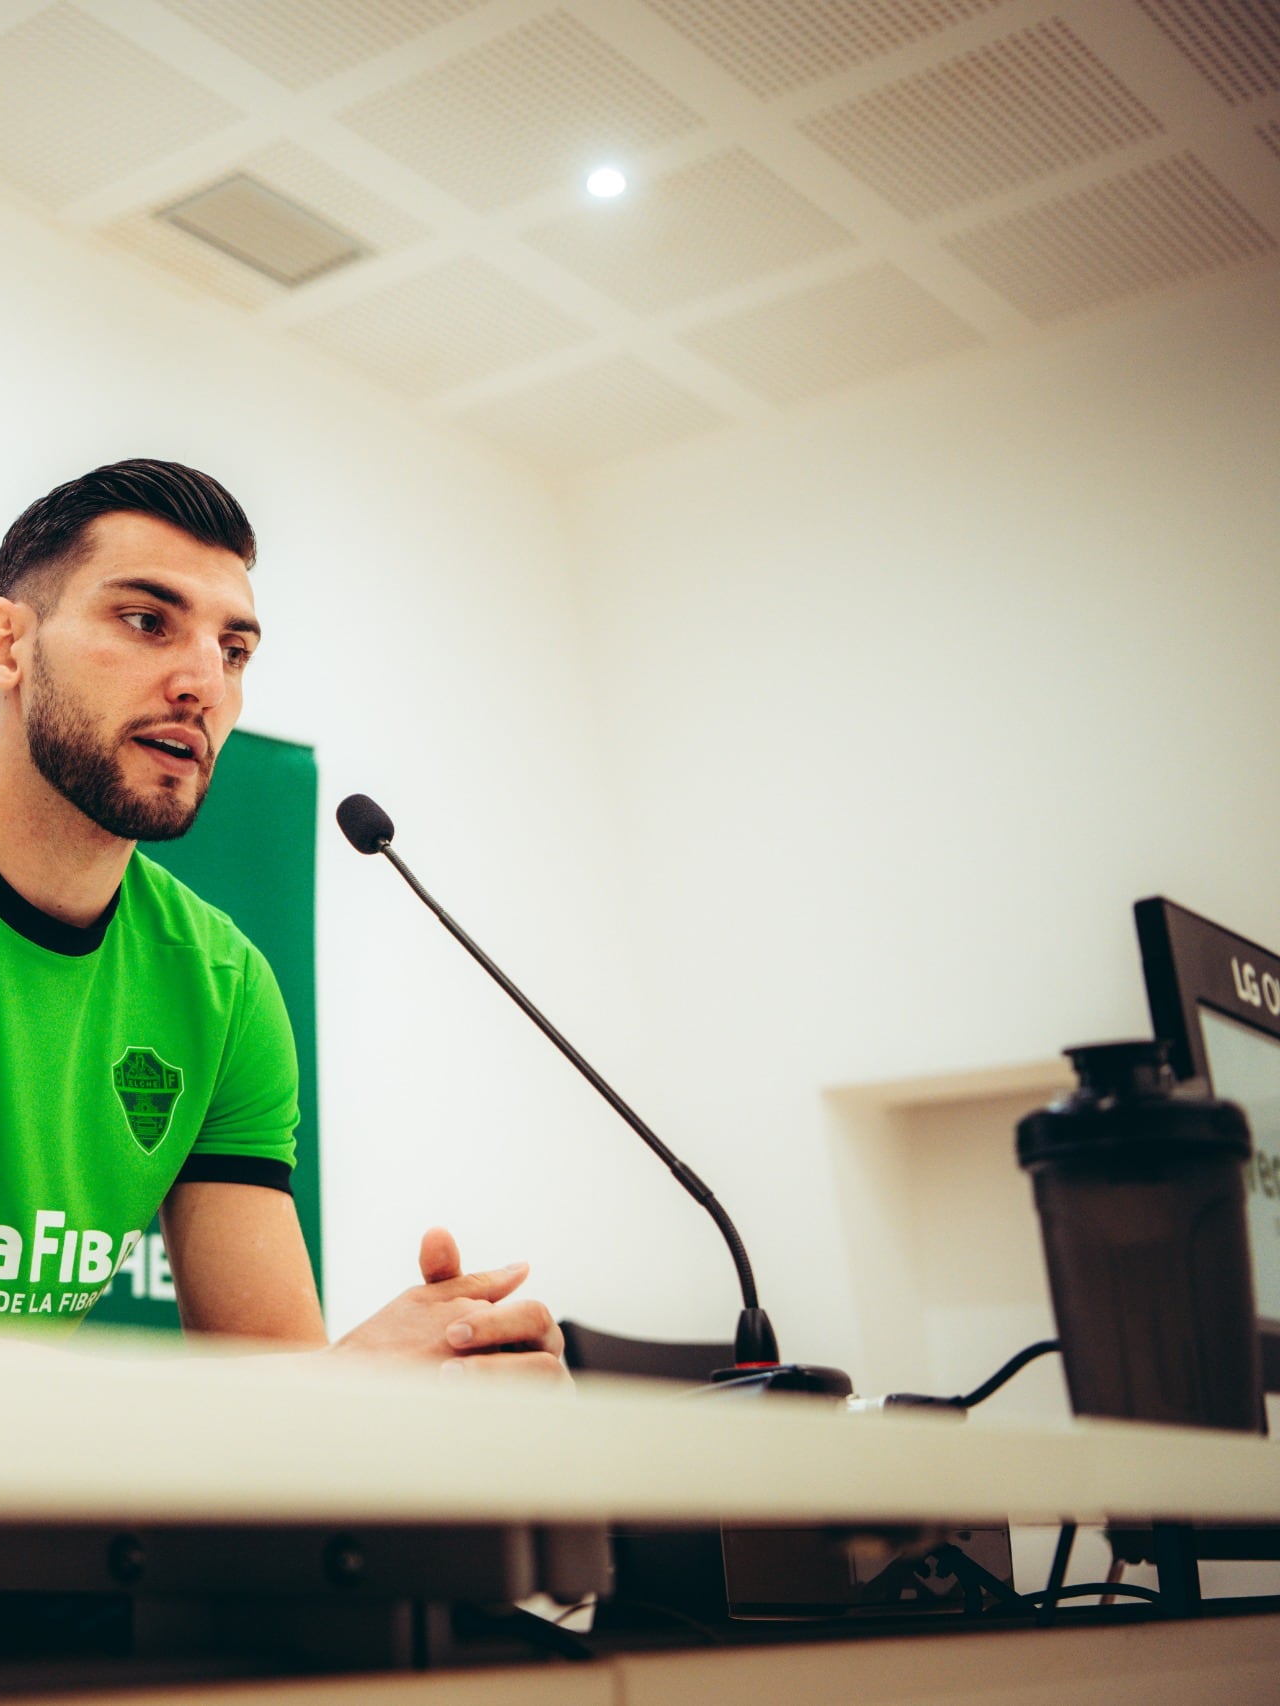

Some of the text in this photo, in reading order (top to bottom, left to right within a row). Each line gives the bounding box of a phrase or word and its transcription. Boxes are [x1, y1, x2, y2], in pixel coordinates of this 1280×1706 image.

[1231, 955, 1262, 1007] LG
[29, 1292, 52, 1313] LA
[58, 1290, 100, 1313] FIBR
